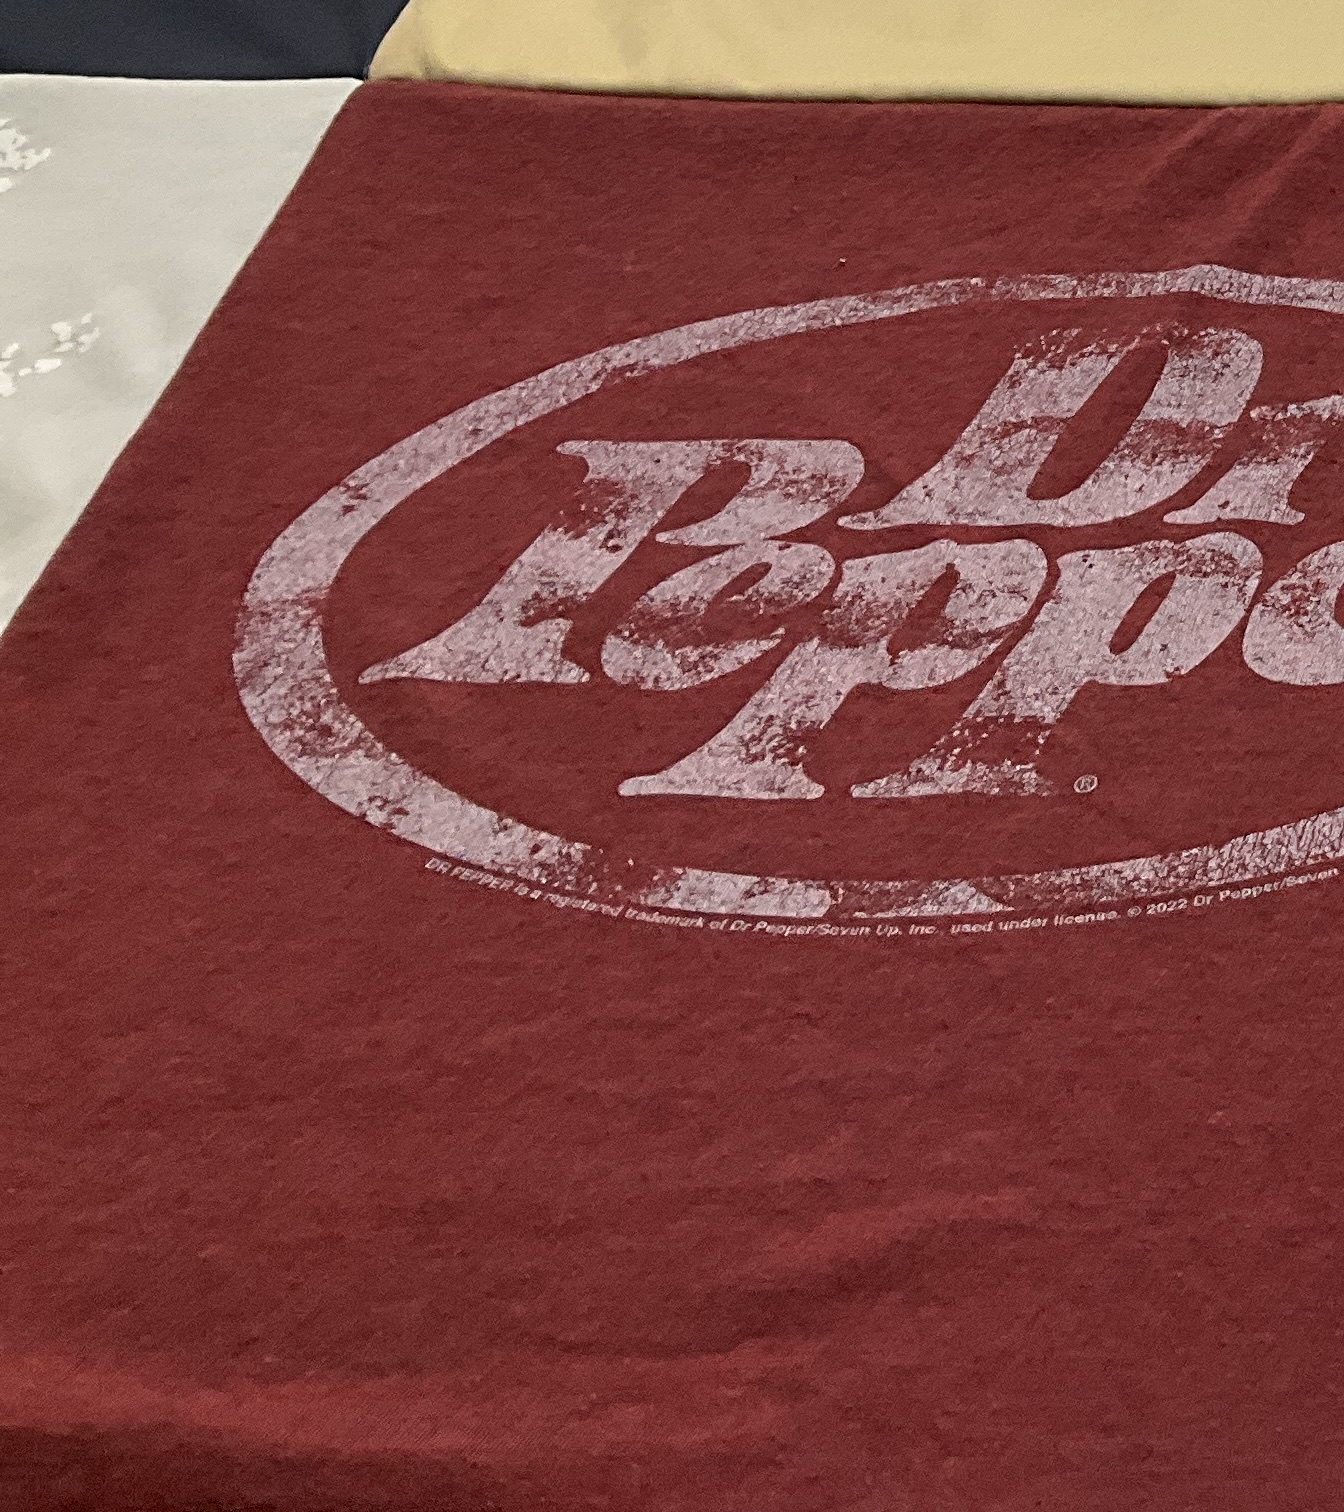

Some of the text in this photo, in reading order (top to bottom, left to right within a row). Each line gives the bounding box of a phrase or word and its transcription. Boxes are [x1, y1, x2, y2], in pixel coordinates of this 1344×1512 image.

[729, 918, 752, 932] Dr
[997, 915, 1049, 933] under
[1146, 897, 1188, 916] 2022
[1193, 893, 1214, 908] Dr
